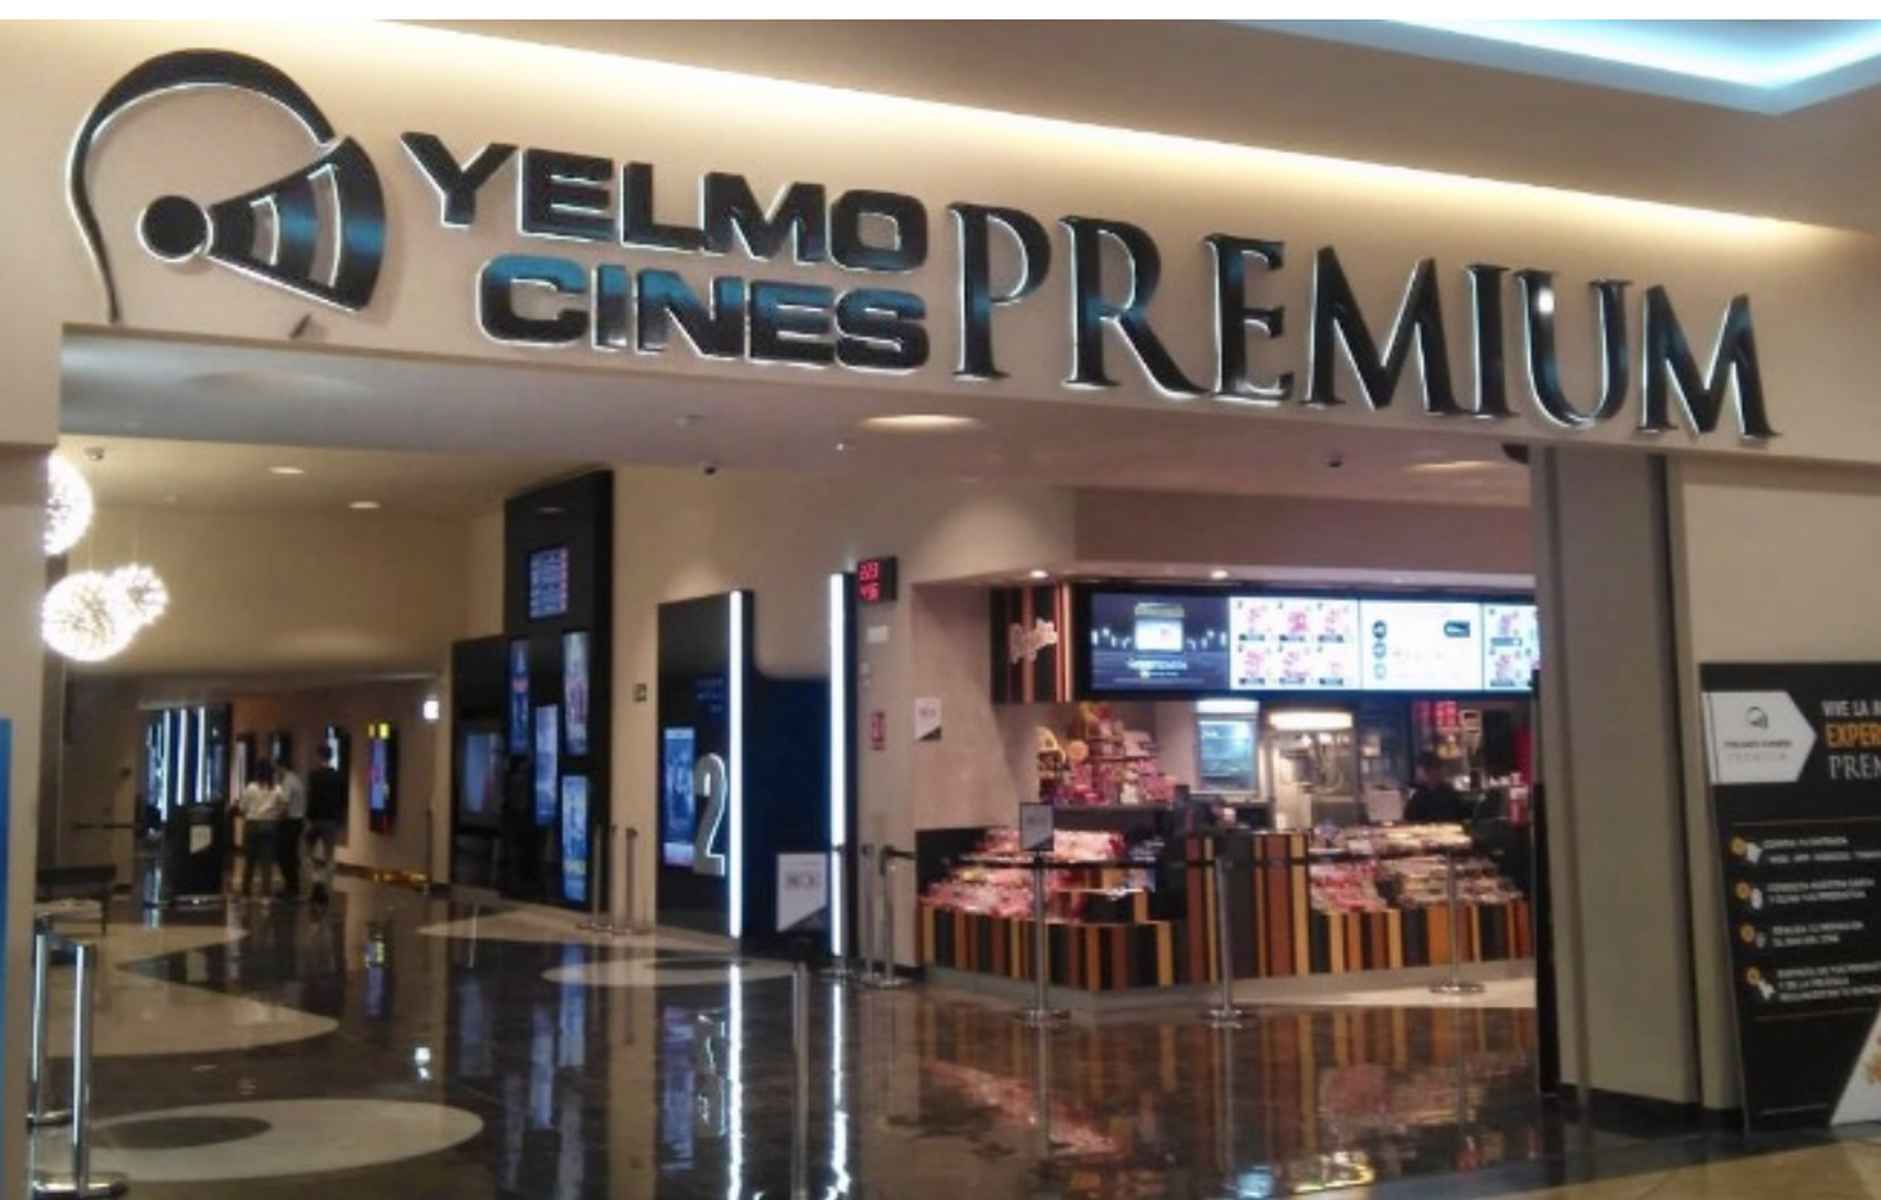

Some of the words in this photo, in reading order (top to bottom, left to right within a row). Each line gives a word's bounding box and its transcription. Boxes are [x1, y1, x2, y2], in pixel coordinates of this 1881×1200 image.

[400, 131, 928, 272] YELMO
[476, 253, 929, 374] CINES
[949, 202, 1782, 439] PREMIUM
[693, 752, 728, 876] 2
